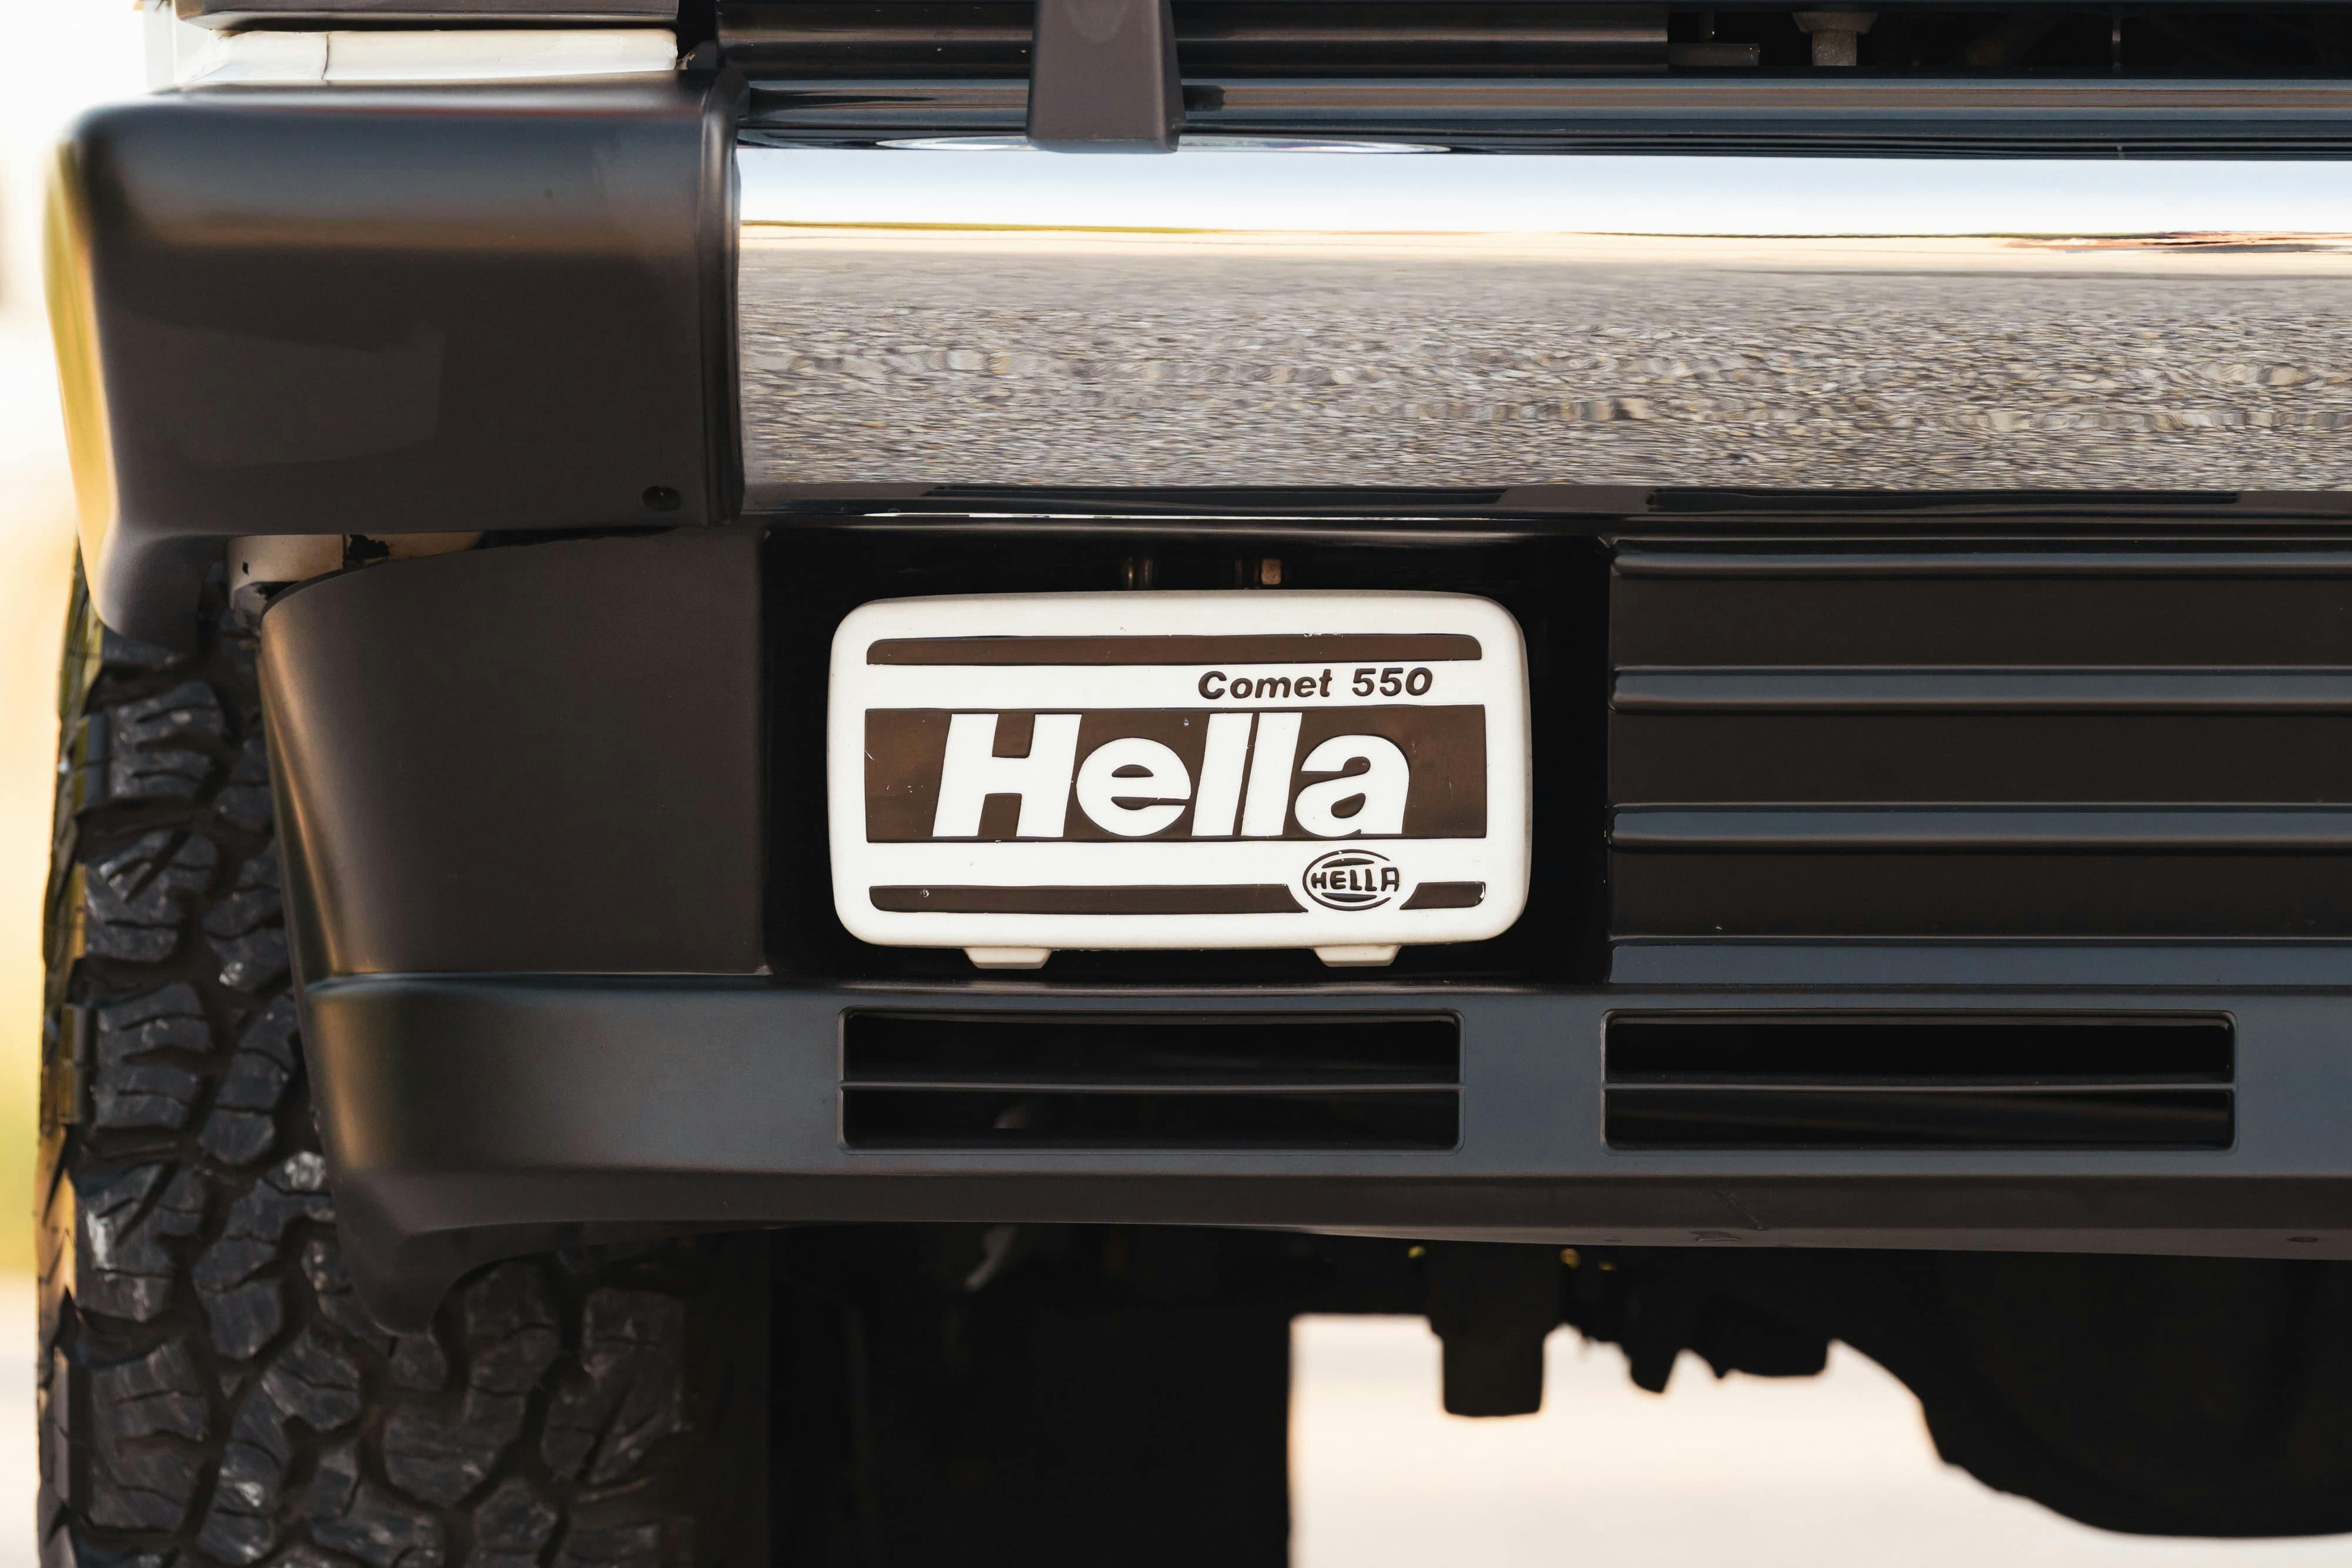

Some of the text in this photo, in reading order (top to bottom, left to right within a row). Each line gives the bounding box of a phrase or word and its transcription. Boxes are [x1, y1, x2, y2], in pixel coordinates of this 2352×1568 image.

[1198, 667, 1434, 700] Comet 550
[932, 712, 1411, 838] Hella
[1310, 867, 1400, 892] HELLA
